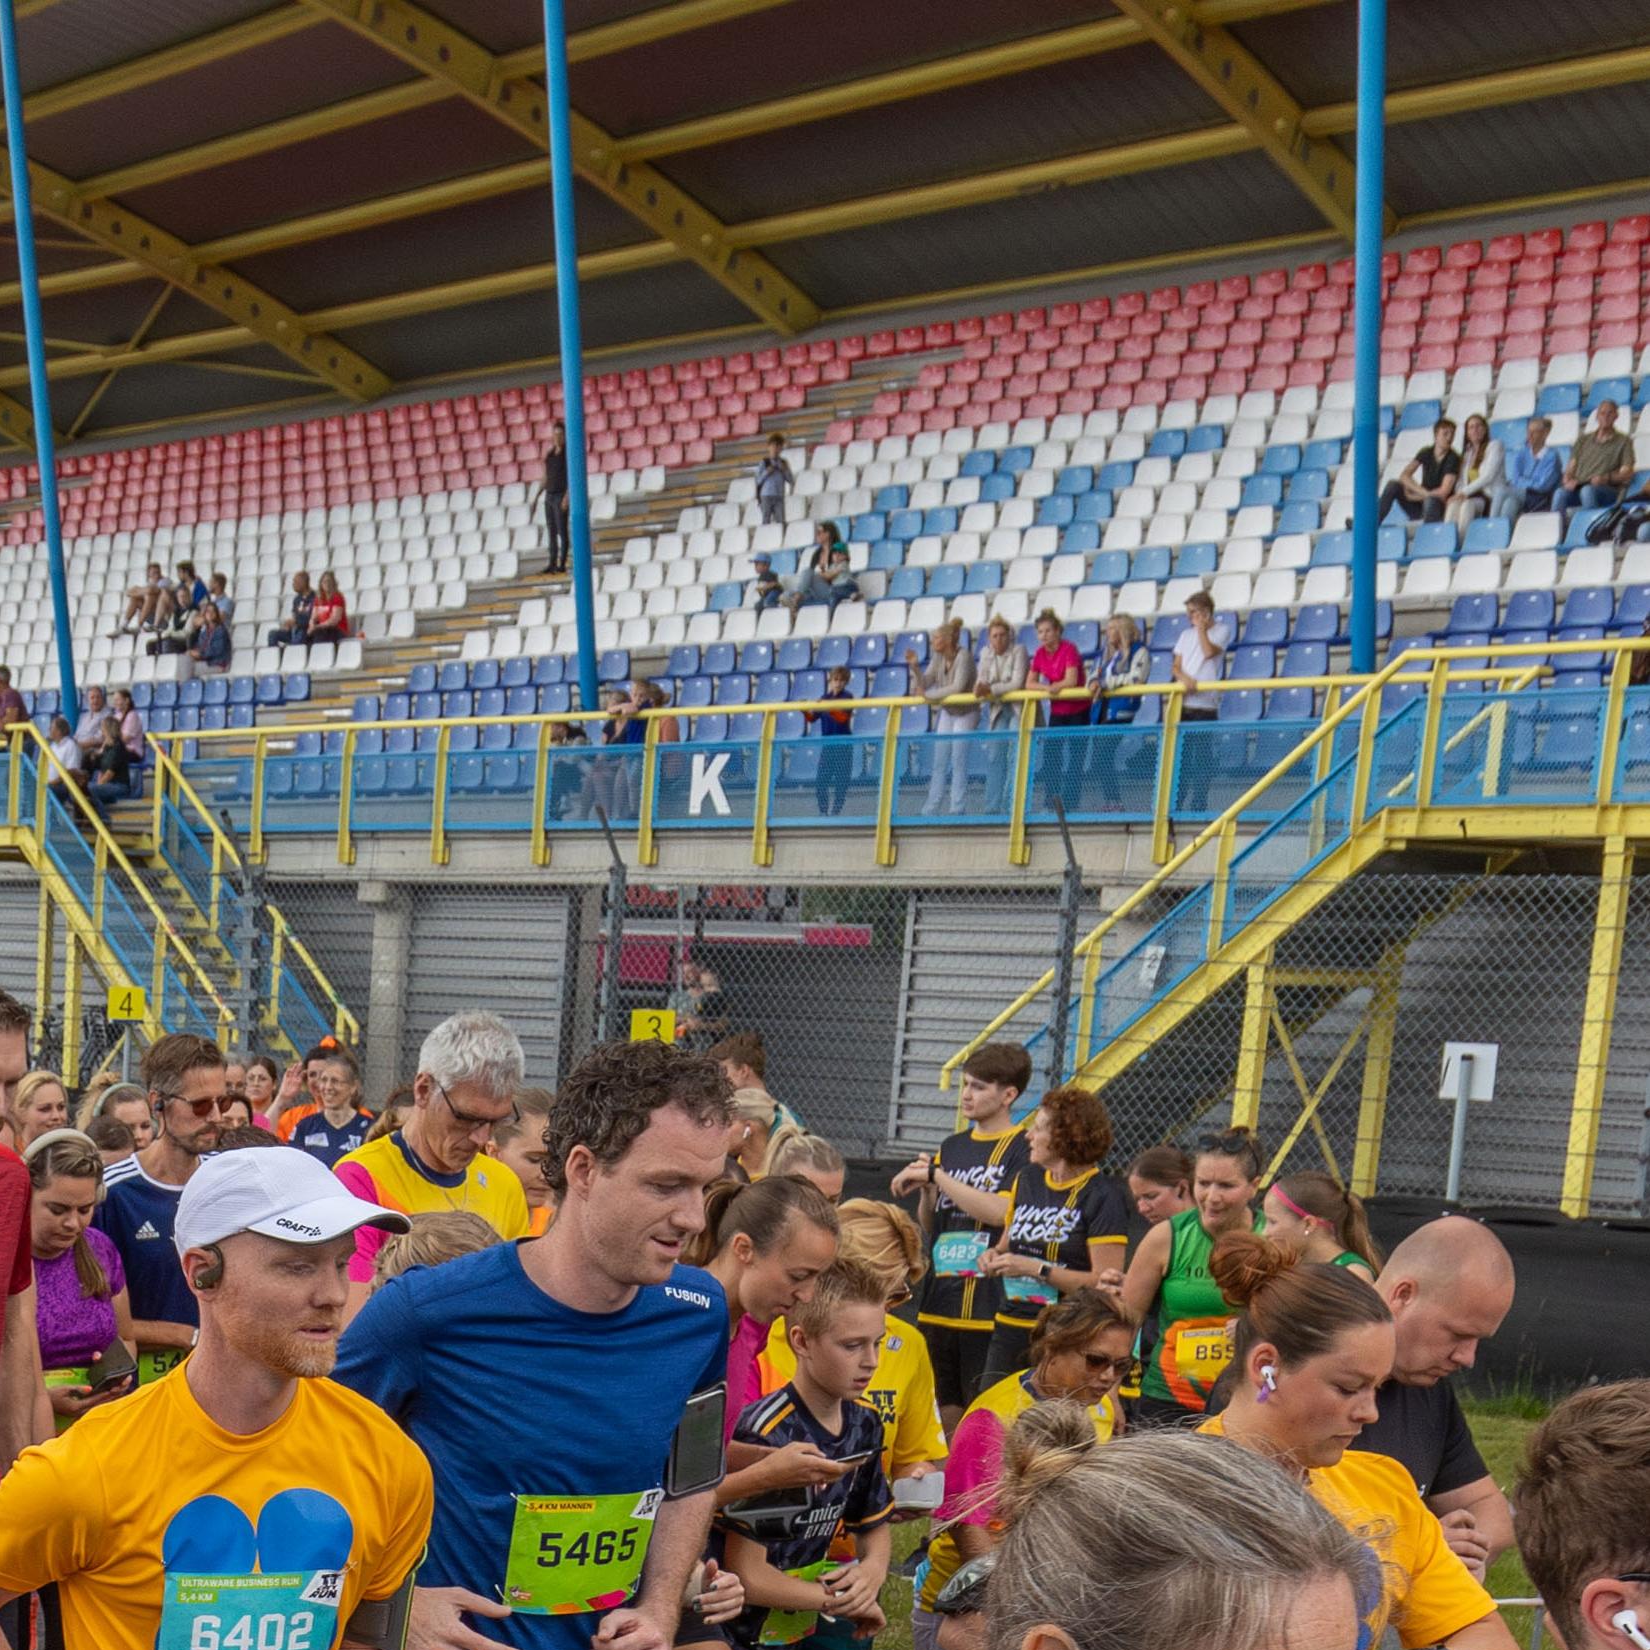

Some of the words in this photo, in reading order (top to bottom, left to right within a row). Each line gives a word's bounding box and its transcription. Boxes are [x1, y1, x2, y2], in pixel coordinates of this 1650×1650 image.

[689, 753, 731, 815] K
[119, 992, 133, 1017] 4
[648, 1016, 662, 1041] 3
[276, 1218, 311, 1236] CRAFT
[938, 1244, 978, 1260] 6423
[664, 1286, 711, 1309] FUSION
[545, 1502, 558, 1511] KM
[559, 1502, 593, 1511] MANNEN
[536, 1526, 639, 1568] 5465
[180, 1577, 235, 1588] ULTRAWARE
[236, 1577, 280, 1588] BUSINESS
[281, 1577, 300, 1586] RUN
[180, 1592, 198, 1604] 5,4
[198, 1592, 213, 1601] KM
